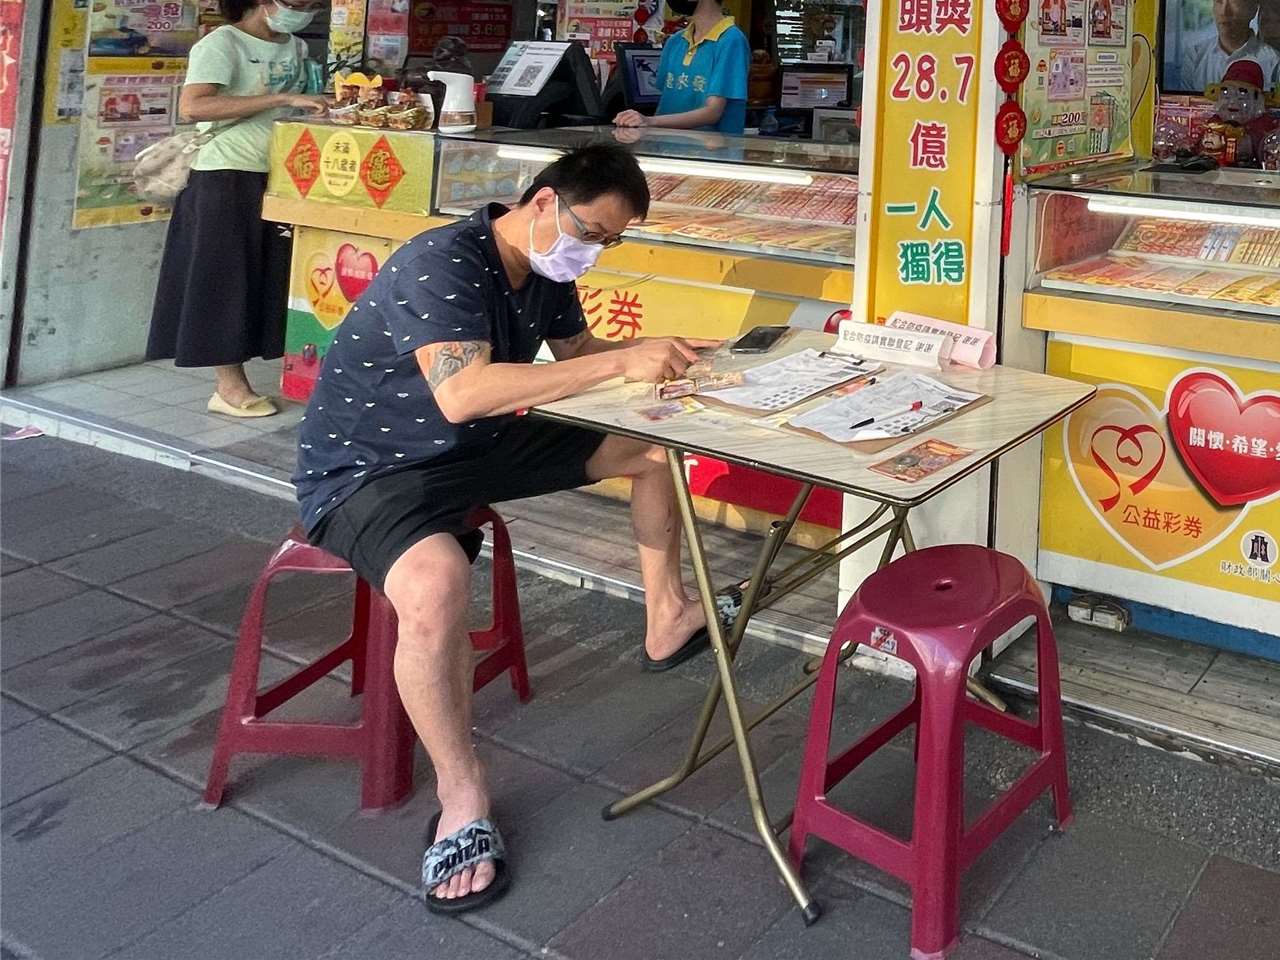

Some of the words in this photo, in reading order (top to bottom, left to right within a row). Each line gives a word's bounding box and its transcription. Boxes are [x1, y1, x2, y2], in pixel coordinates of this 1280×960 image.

[890, 53, 975, 103] 28.7
[909, 121, 948, 170] 億
[886, 189, 951, 230] 一人
[898, 240, 966, 284] 獨得
[1121, 504, 1204, 539] 公益彩券
